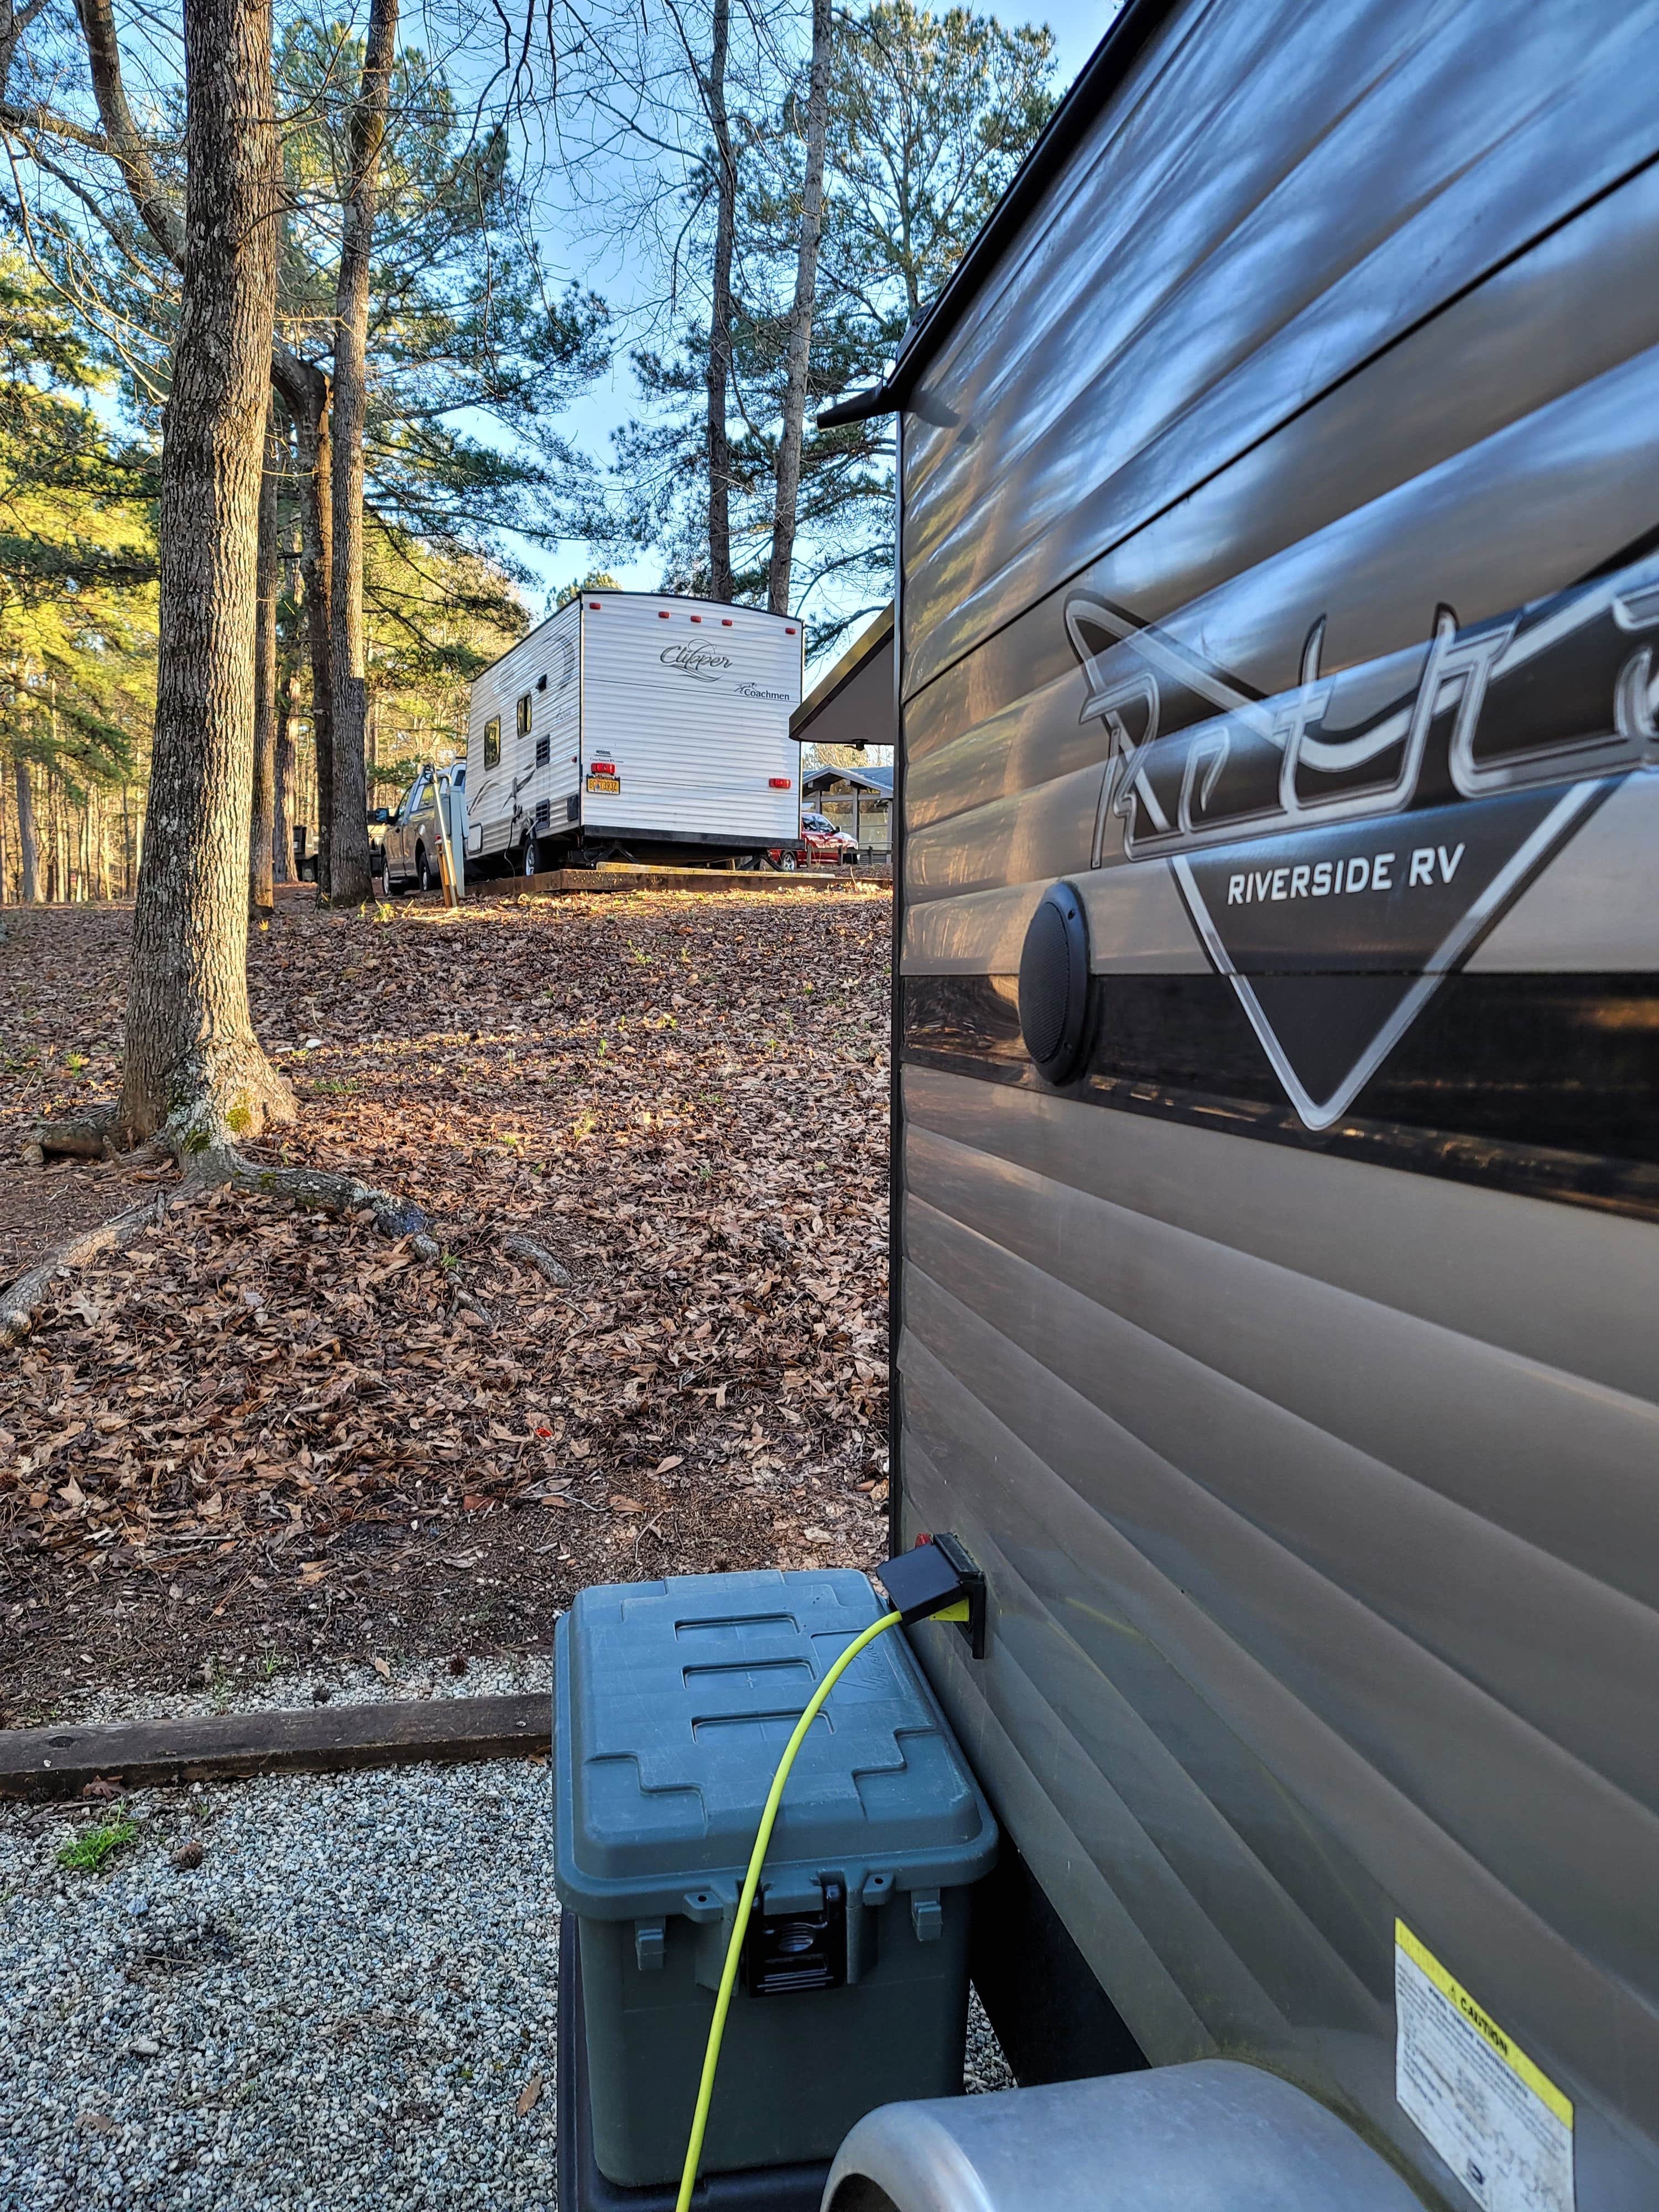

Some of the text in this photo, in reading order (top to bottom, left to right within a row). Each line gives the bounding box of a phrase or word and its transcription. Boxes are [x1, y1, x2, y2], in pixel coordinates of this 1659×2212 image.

[660, 638, 733, 671] Clipper
[744, 688, 790, 701] Coachmen
[1227, 842, 1466, 906] RIVERSIDE RV
[1460, 1997, 1508, 2056] CAUTION
